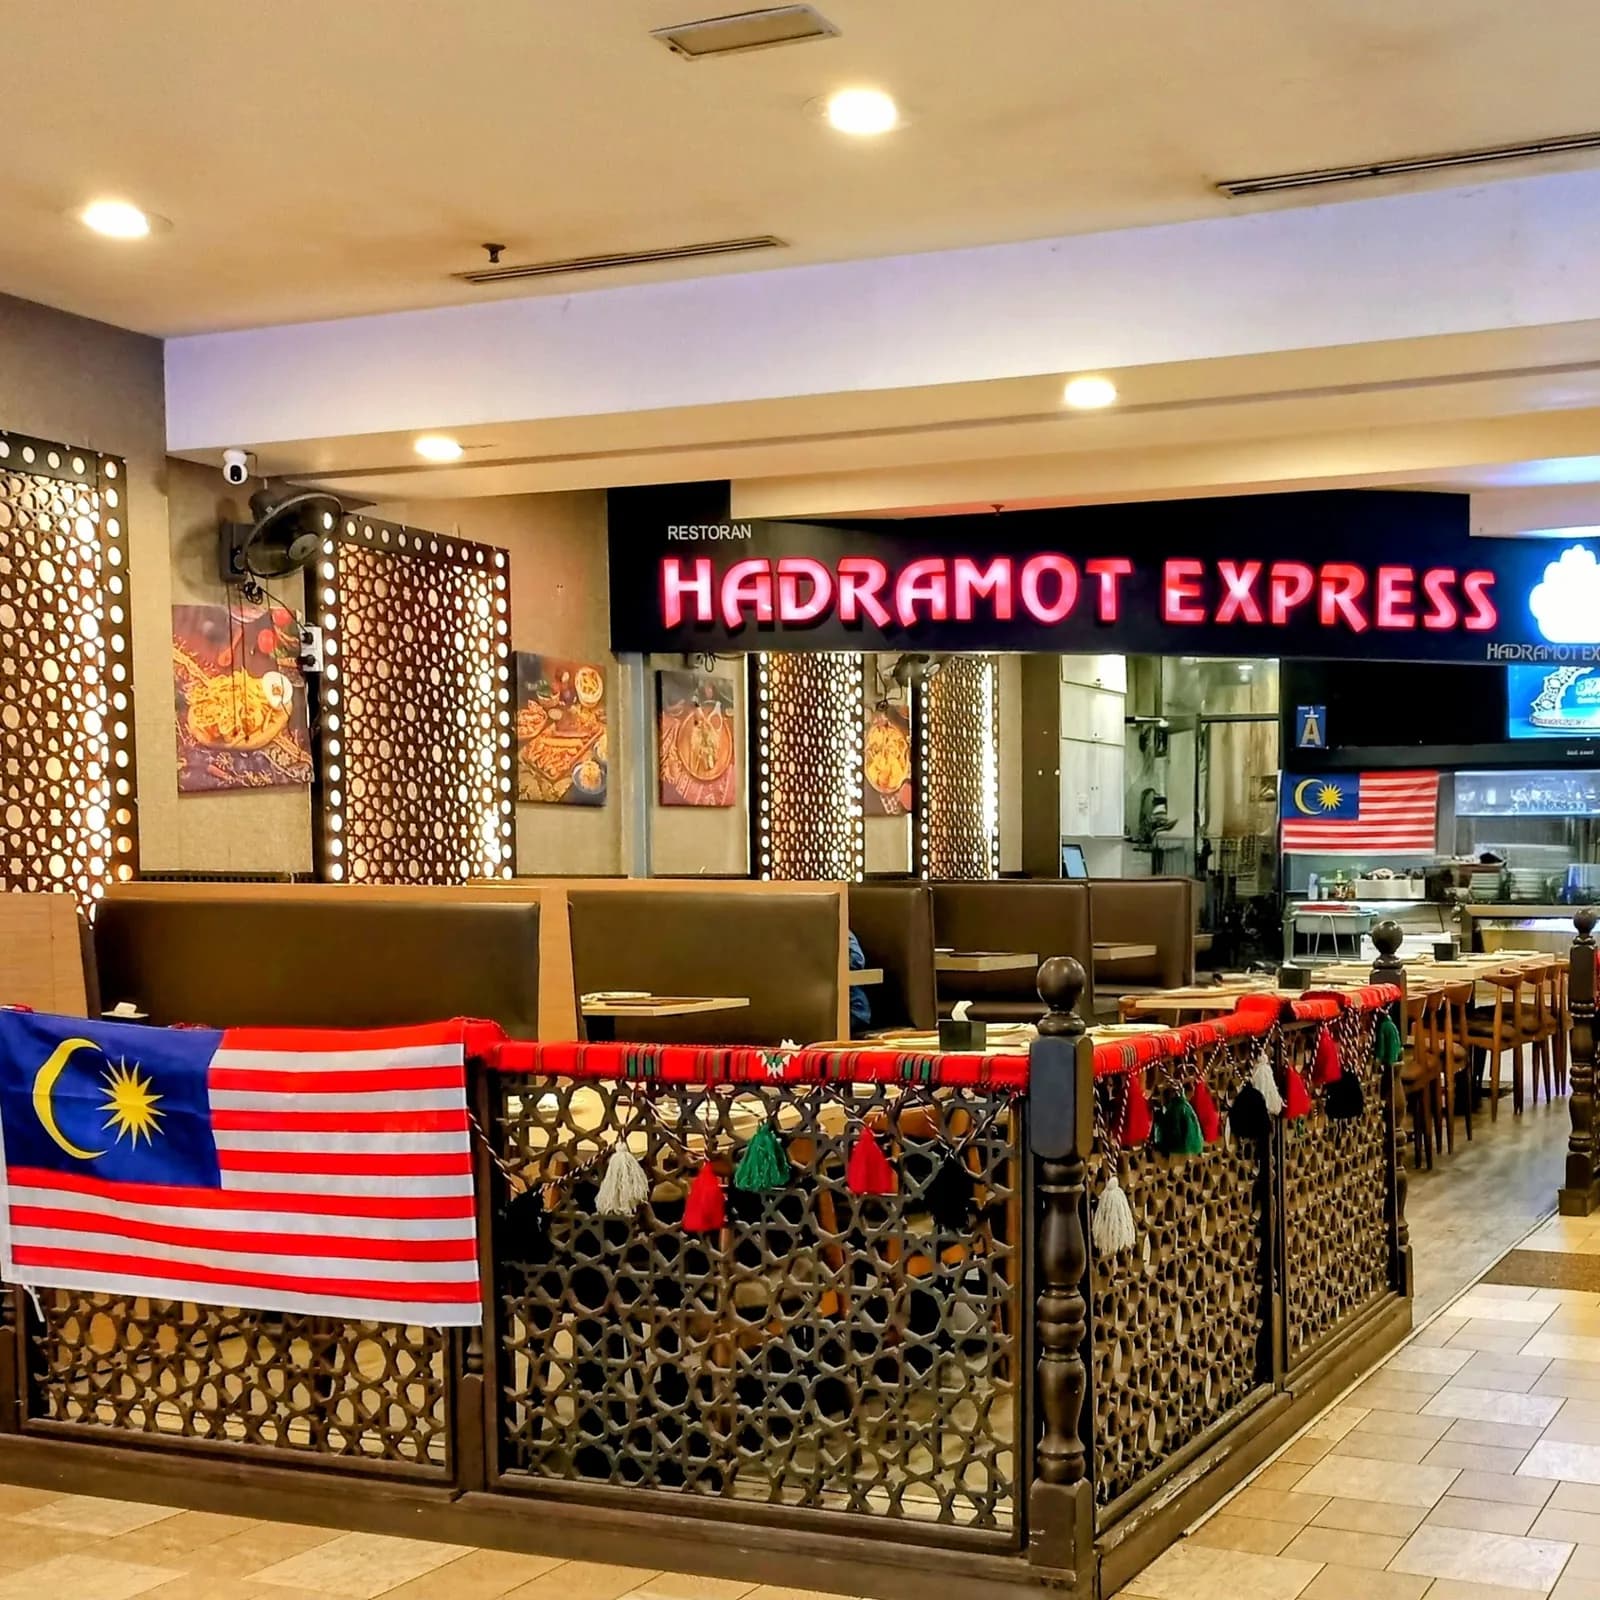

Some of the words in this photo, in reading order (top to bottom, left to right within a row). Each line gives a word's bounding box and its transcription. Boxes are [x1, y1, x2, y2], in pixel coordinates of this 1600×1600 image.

[667, 524, 752, 541] RESTORAN
[661, 553, 1134, 629] HADRAMOT
[1163, 558, 1498, 632] EXPRESS
[1486, 642, 1577, 661] HADRAMOT
